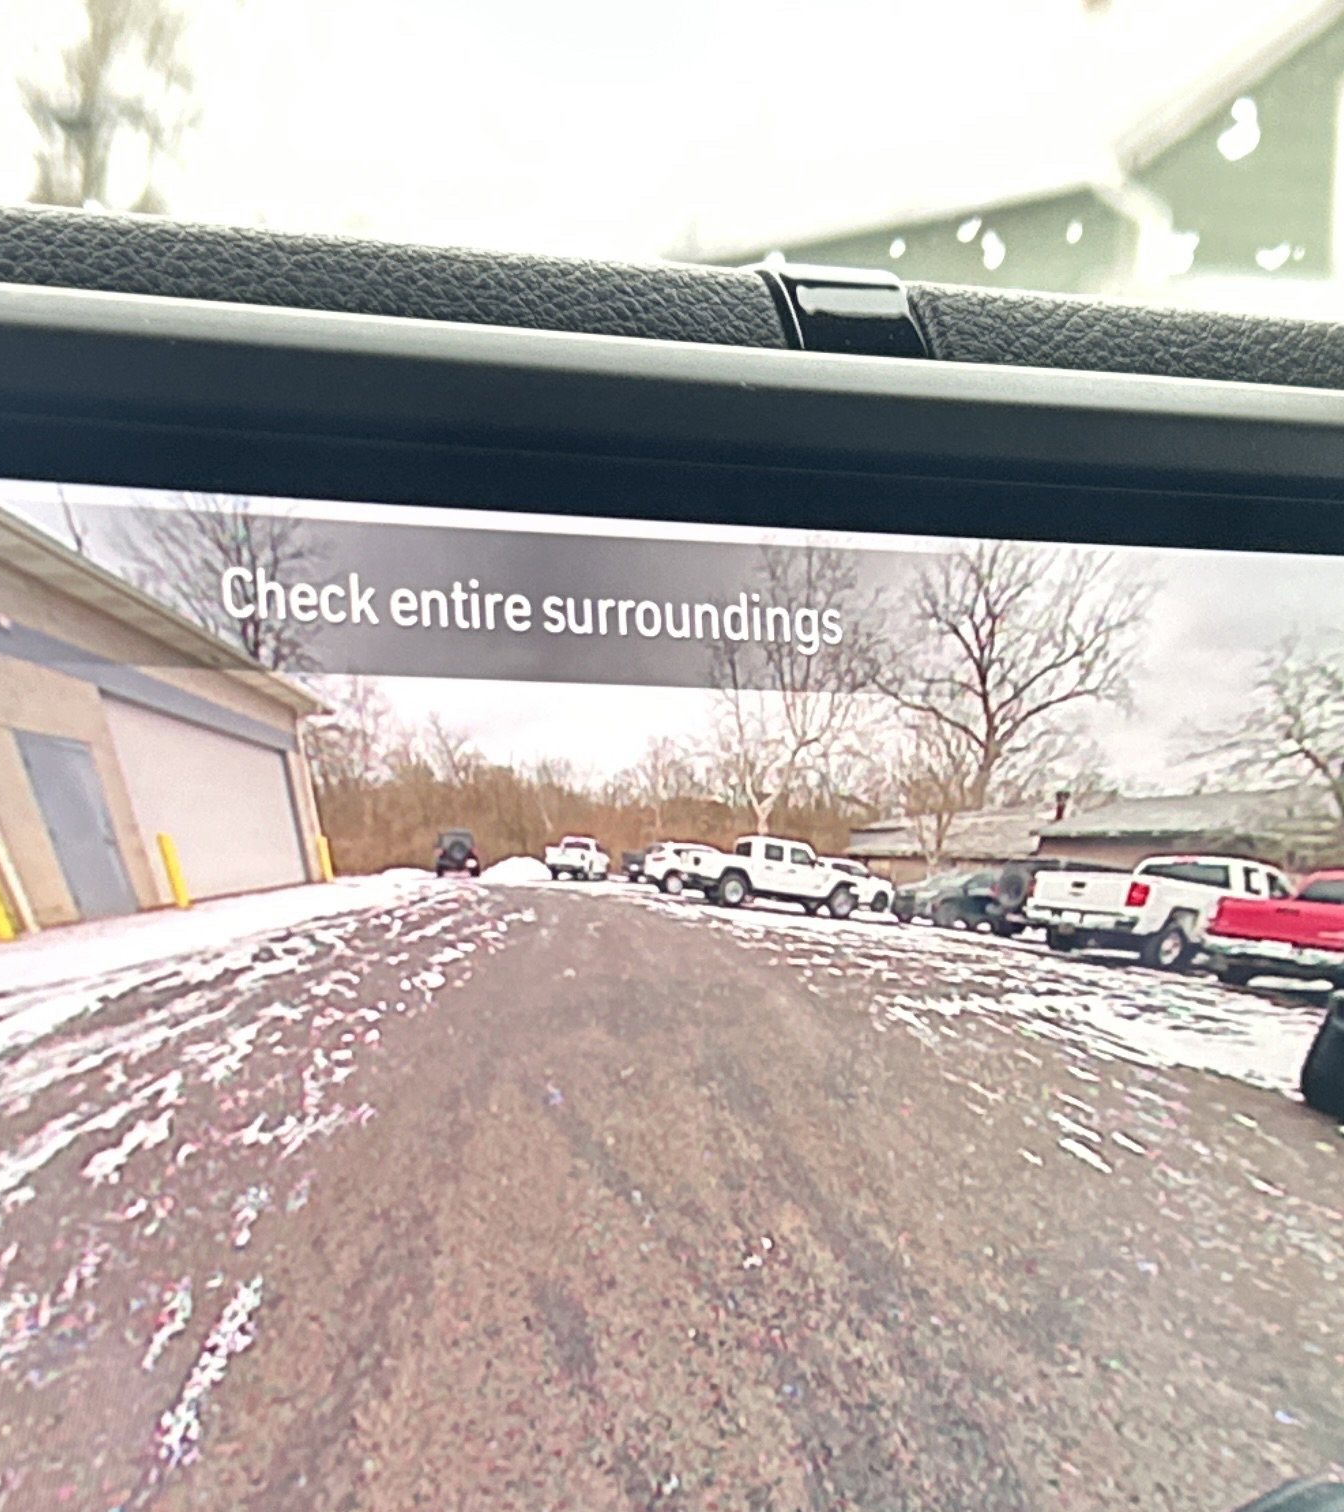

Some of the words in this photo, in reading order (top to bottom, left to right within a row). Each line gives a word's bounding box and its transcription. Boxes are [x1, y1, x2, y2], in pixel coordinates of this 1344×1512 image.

[220, 565, 380, 627] Check
[390, 577, 533, 633] entire
[542, 592, 845, 656] surroundings
